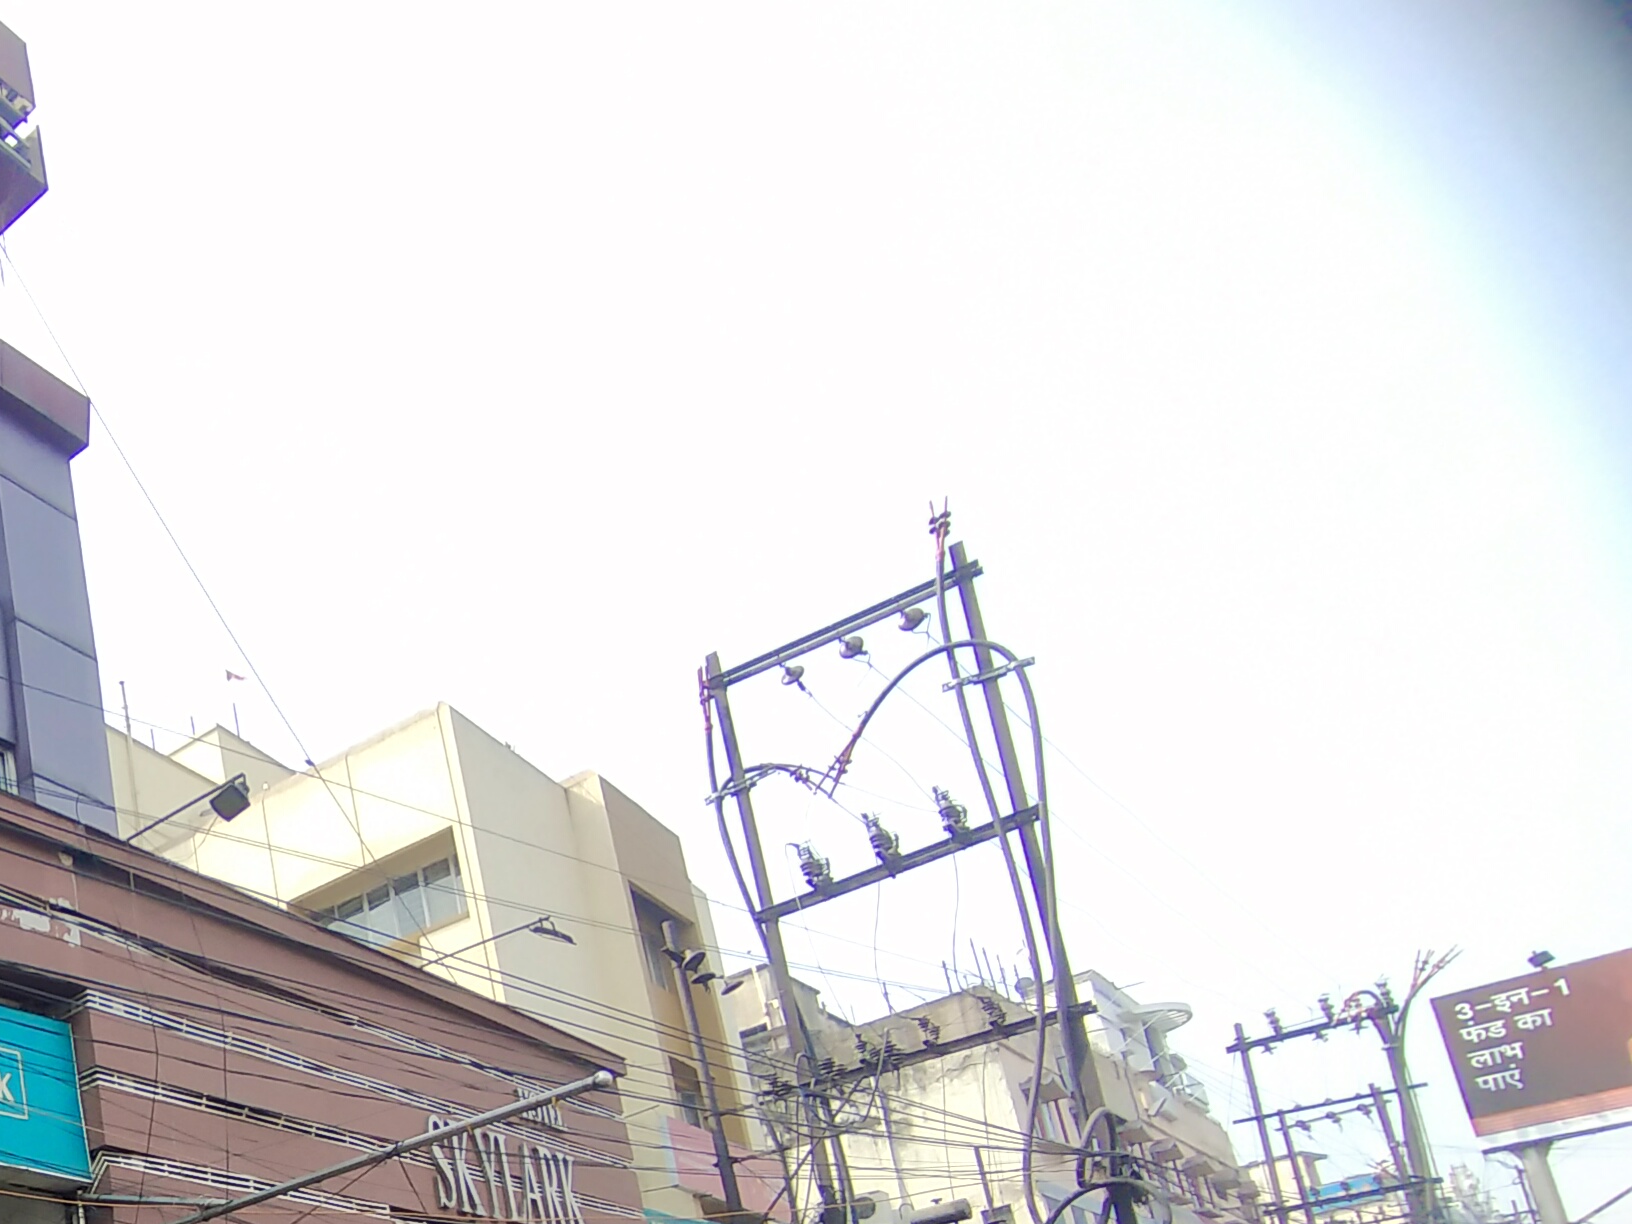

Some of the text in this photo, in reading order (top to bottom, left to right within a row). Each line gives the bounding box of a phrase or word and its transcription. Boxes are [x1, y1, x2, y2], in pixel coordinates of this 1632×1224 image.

[1459, 1008, 1553, 1043] फंड का
[1467, 1041, 1524, 1068] लाभ
[1475, 1063, 1524, 1091] पाएं
